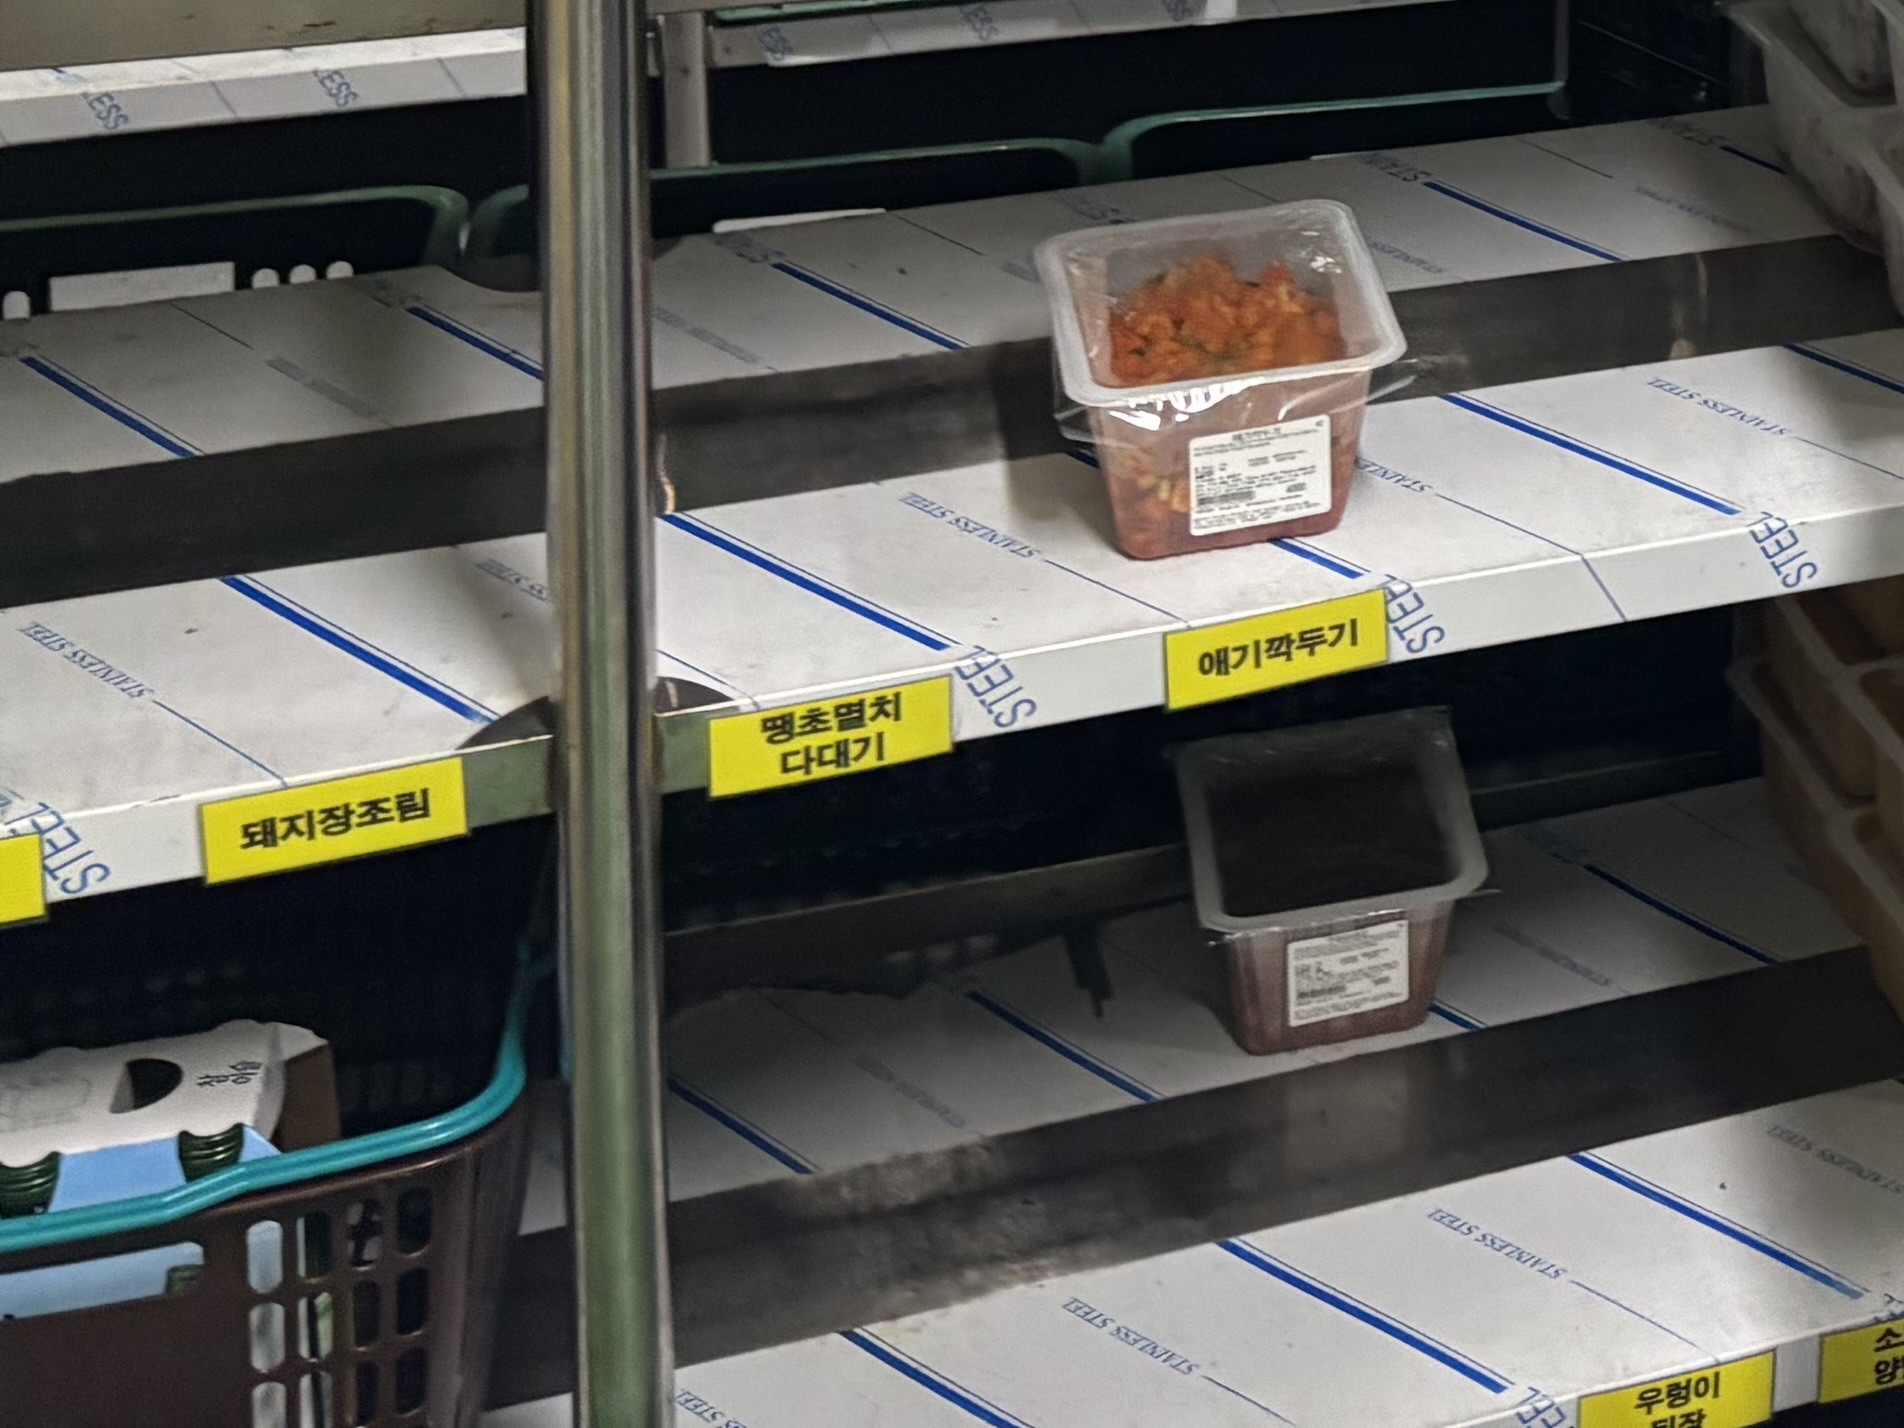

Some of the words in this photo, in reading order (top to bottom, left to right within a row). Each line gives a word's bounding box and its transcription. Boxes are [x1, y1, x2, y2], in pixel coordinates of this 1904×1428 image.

[1747, 511, 1818, 589] STEEL
[1197, 620, 1361, 677] 애기깍두기
[954, 645, 1038, 729] STEEL
[759, 692, 904, 747] 땡초멸치
[779, 731, 887, 778] 다대기
[240, 787, 433, 852] 돼지장조림
[1632, 1371, 1722, 1414] 우렁이
